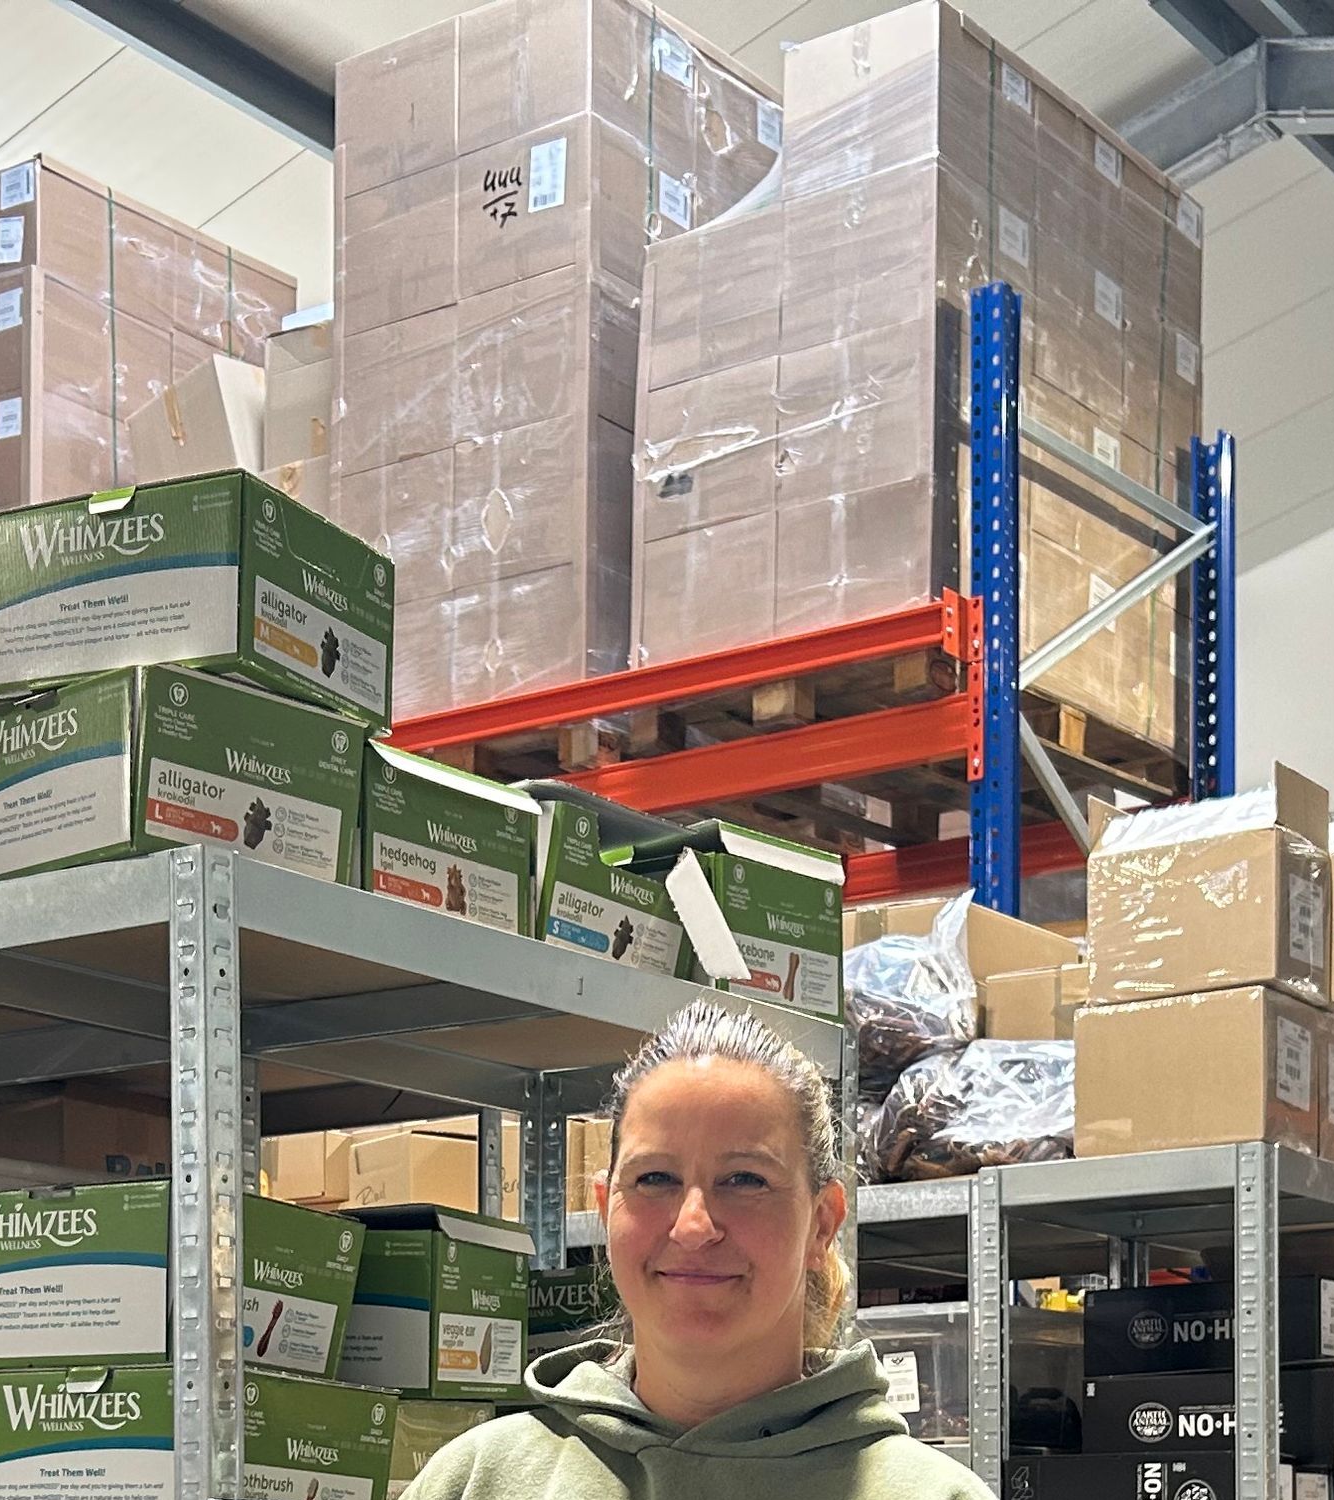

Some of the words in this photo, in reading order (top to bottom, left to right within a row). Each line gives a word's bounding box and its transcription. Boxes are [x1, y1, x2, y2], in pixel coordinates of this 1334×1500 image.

[260, 589, 308, 626] alligator
[158, 769, 226, 801] alligator
[380, 842, 437, 875] hedgehog
[557, 890, 605, 919] alligator
[20, 1285, 41, 1294] Them
[528, 1279, 599, 1316] IMZEES
[2, 1383, 142, 1432] WHIMZEES
[40, 1468, 60, 1477] Treat
[62, 1468, 84, 1477] Them
